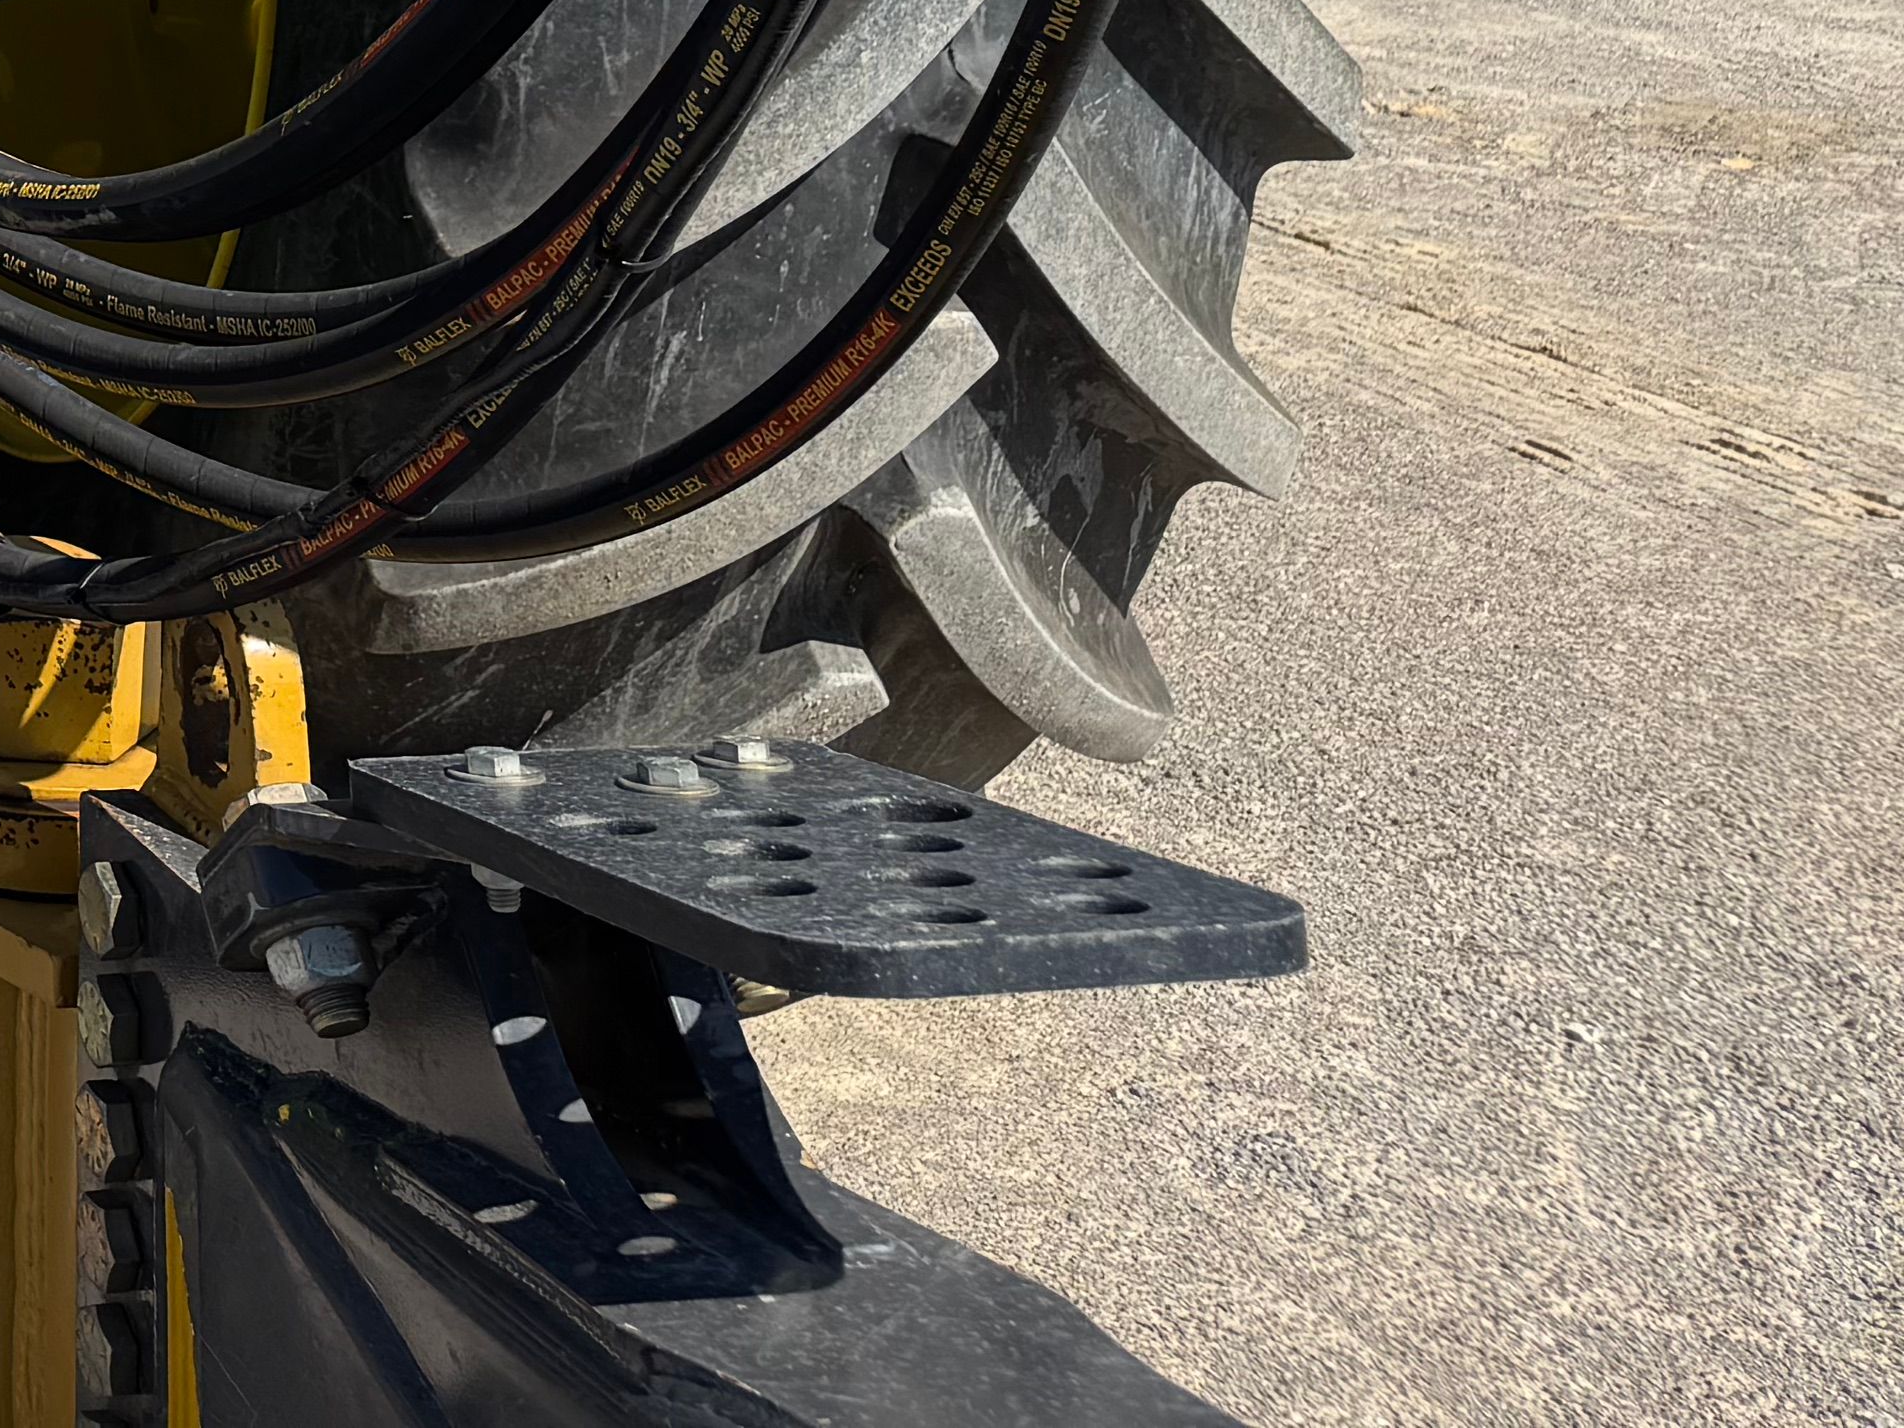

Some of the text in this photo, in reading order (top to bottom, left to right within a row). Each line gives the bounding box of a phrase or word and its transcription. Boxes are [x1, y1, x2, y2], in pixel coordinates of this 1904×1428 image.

[675, 89, 704, 133] 3/4"
[700, 48, 730, 87] WP
[1018, 93, 1042, 121] TYPE
[36, 266, 58, 290] WP
[106, 295, 145, 321] Flame
[147, 304, 208, 334] Resistant
[216, 316, 259, 338] MSHA
[258, 317, 317, 338] IC-252/00
[414, 316, 472, 354] BALFLEX
[486, 259, 544, 311] BALPAC
[889, 238, 953, 313] EXCEEDS
[644, 311, 896, 513] BALFLEX BALPAC PREMIUM R16-4K
[228, 554, 283, 587] BALFLEX
[360, 460, 422, 514] PRMIUM
